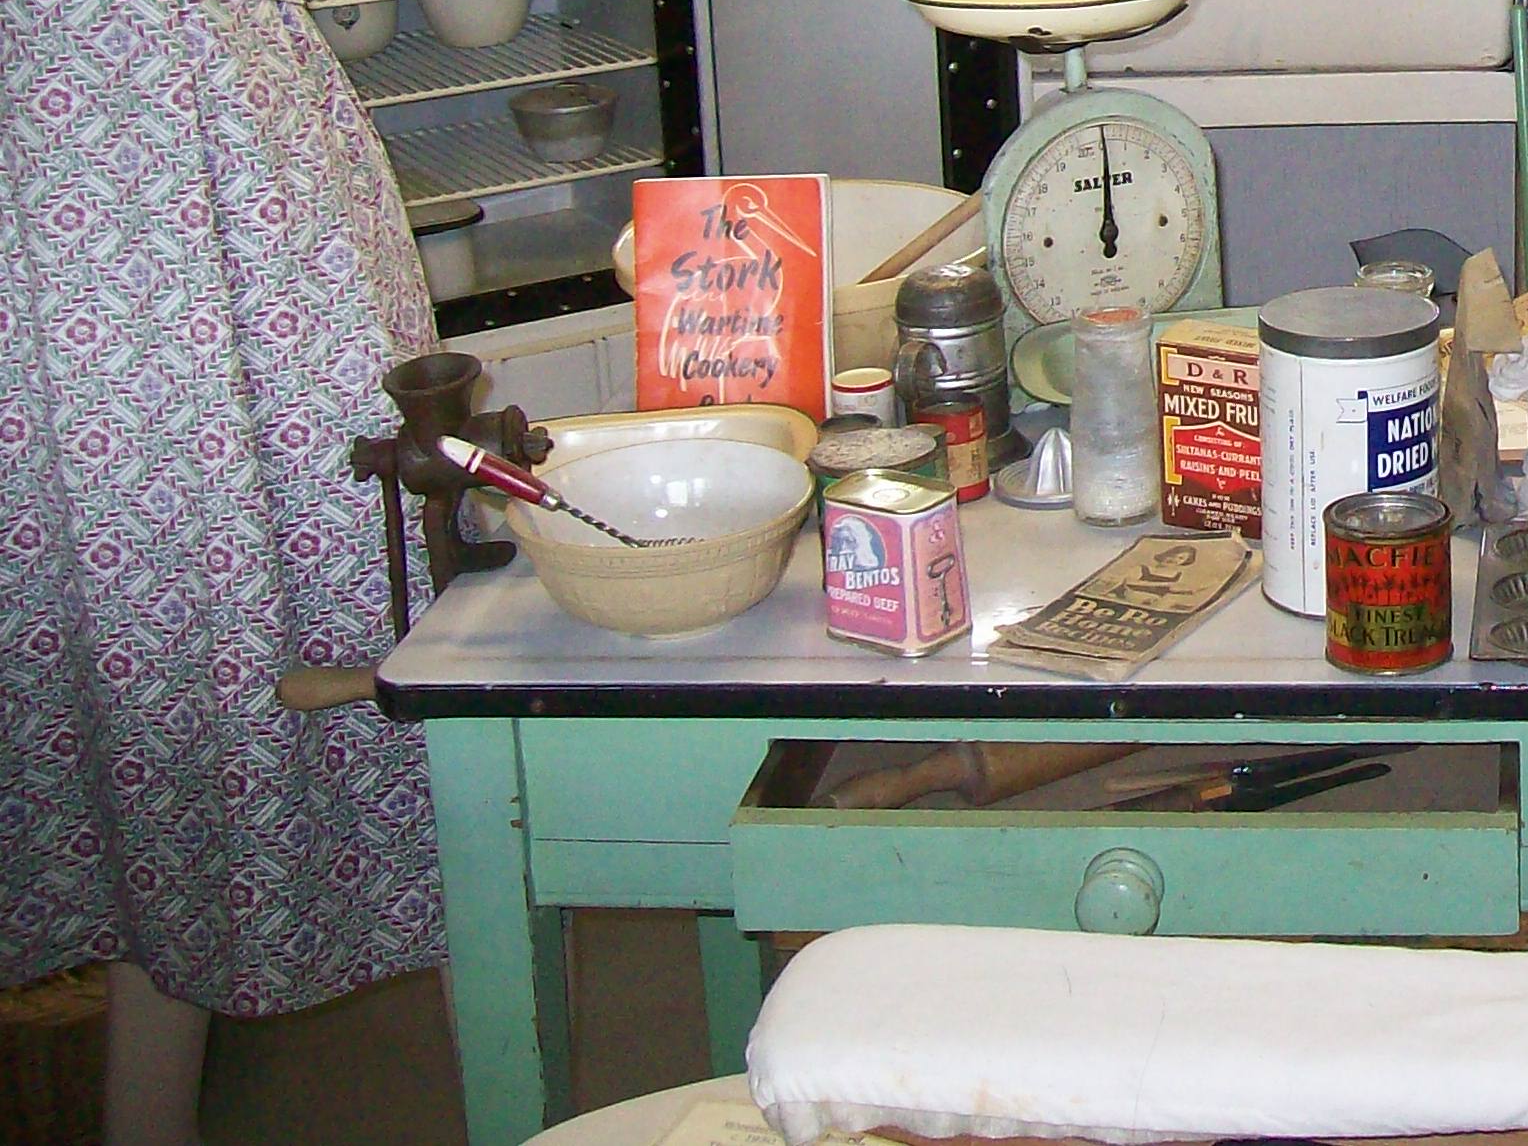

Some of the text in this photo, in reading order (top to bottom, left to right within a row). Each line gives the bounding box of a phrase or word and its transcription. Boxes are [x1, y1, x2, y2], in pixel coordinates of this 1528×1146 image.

[701, 204, 749, 241] The
[671, 249, 781, 294] Stork
[676, 307, 784, 336] Wartime
[683, 350, 779, 388] Cookery
[1187, 362, 1248, 385] D & R
[1183, 384, 1204, 396] NEW
[1372, 387, 1417, 406] WELFARE
[1164, 393, 1259, 425] MIXED FRU
[1388, 405, 1437, 443] NATIO
[1221, 450, 1261, 466] CURRANT
[1377, 442, 1429, 479] DRIED
[1238, 468, 1261, 482] PEEL
[1183, 495, 1207, 508] CAKES
[845, 566, 900, 590] BENTOS
[873, 596, 899, 613] BEEF
[1050, 611, 1153, 638] Home
